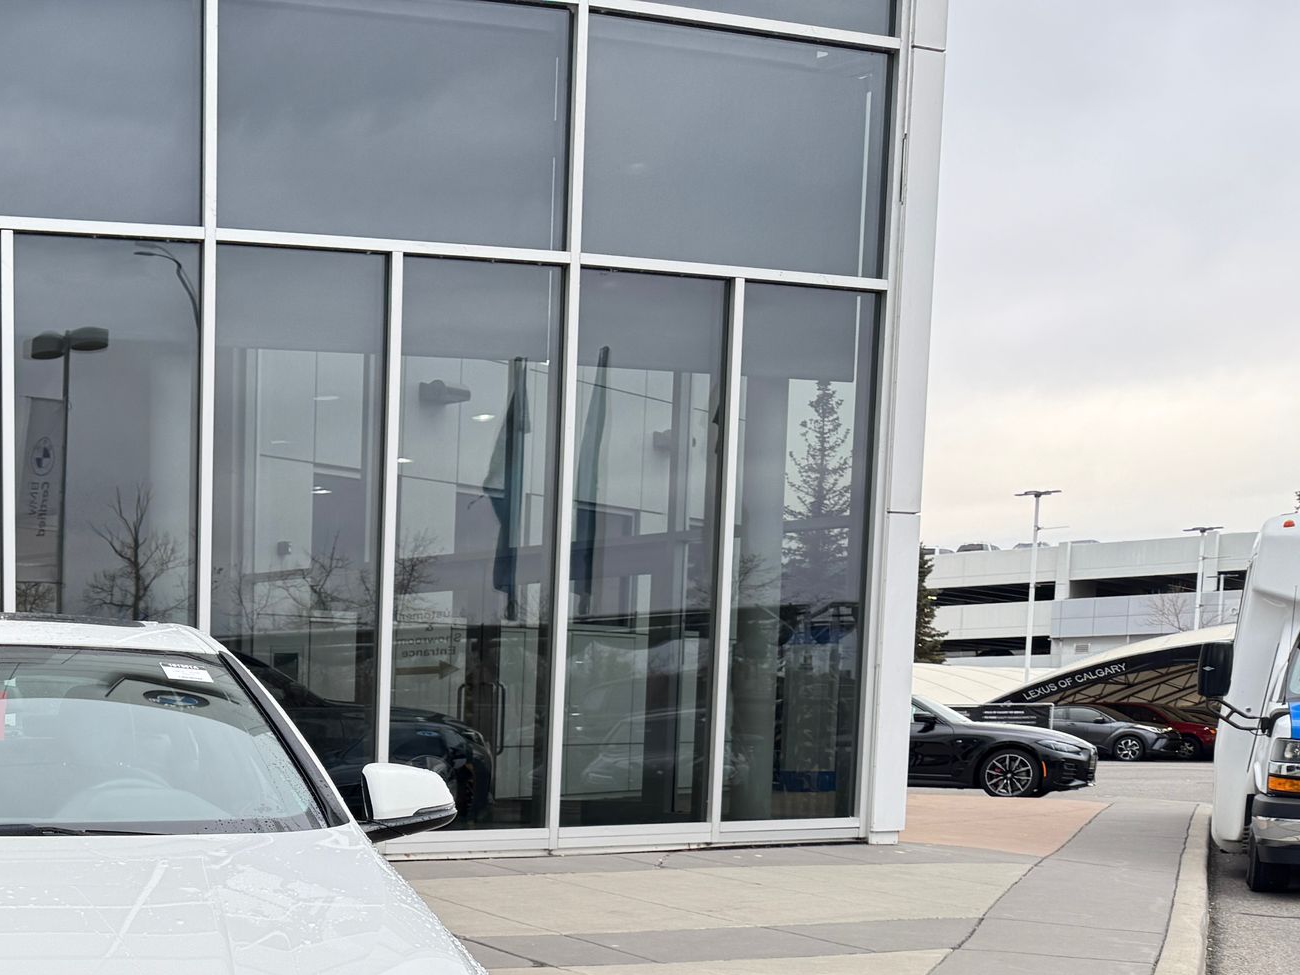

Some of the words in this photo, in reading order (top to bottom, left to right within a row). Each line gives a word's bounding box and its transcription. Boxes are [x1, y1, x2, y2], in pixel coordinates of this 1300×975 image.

[1023, 682, 1058, 701] LEXUS
[1058, 677, 1073, 689] OF
[1075, 662, 1126, 683] CALGARY
